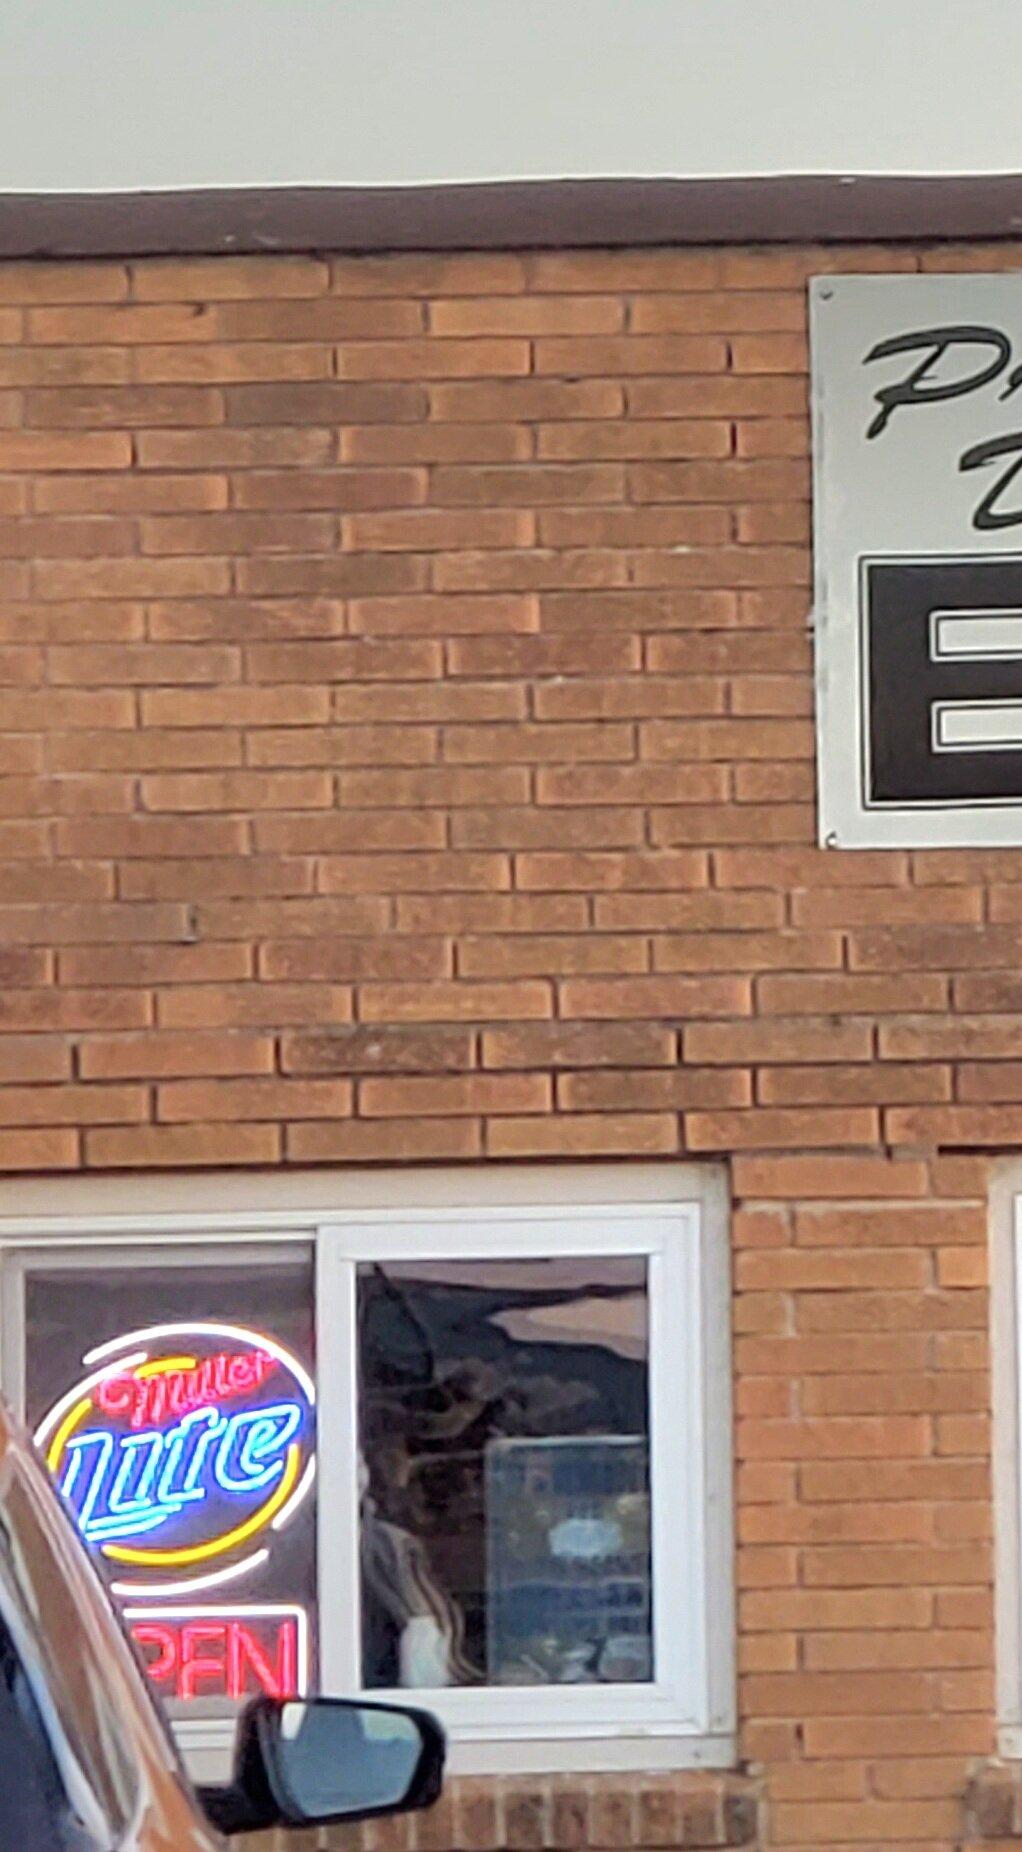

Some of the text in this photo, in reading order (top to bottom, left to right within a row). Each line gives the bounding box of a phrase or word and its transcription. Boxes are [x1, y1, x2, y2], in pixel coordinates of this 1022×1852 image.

[96, 1348, 280, 1428] Miller
[60, 1402, 304, 1544] Lite
[131, 1620, 298, 1702] PEN
